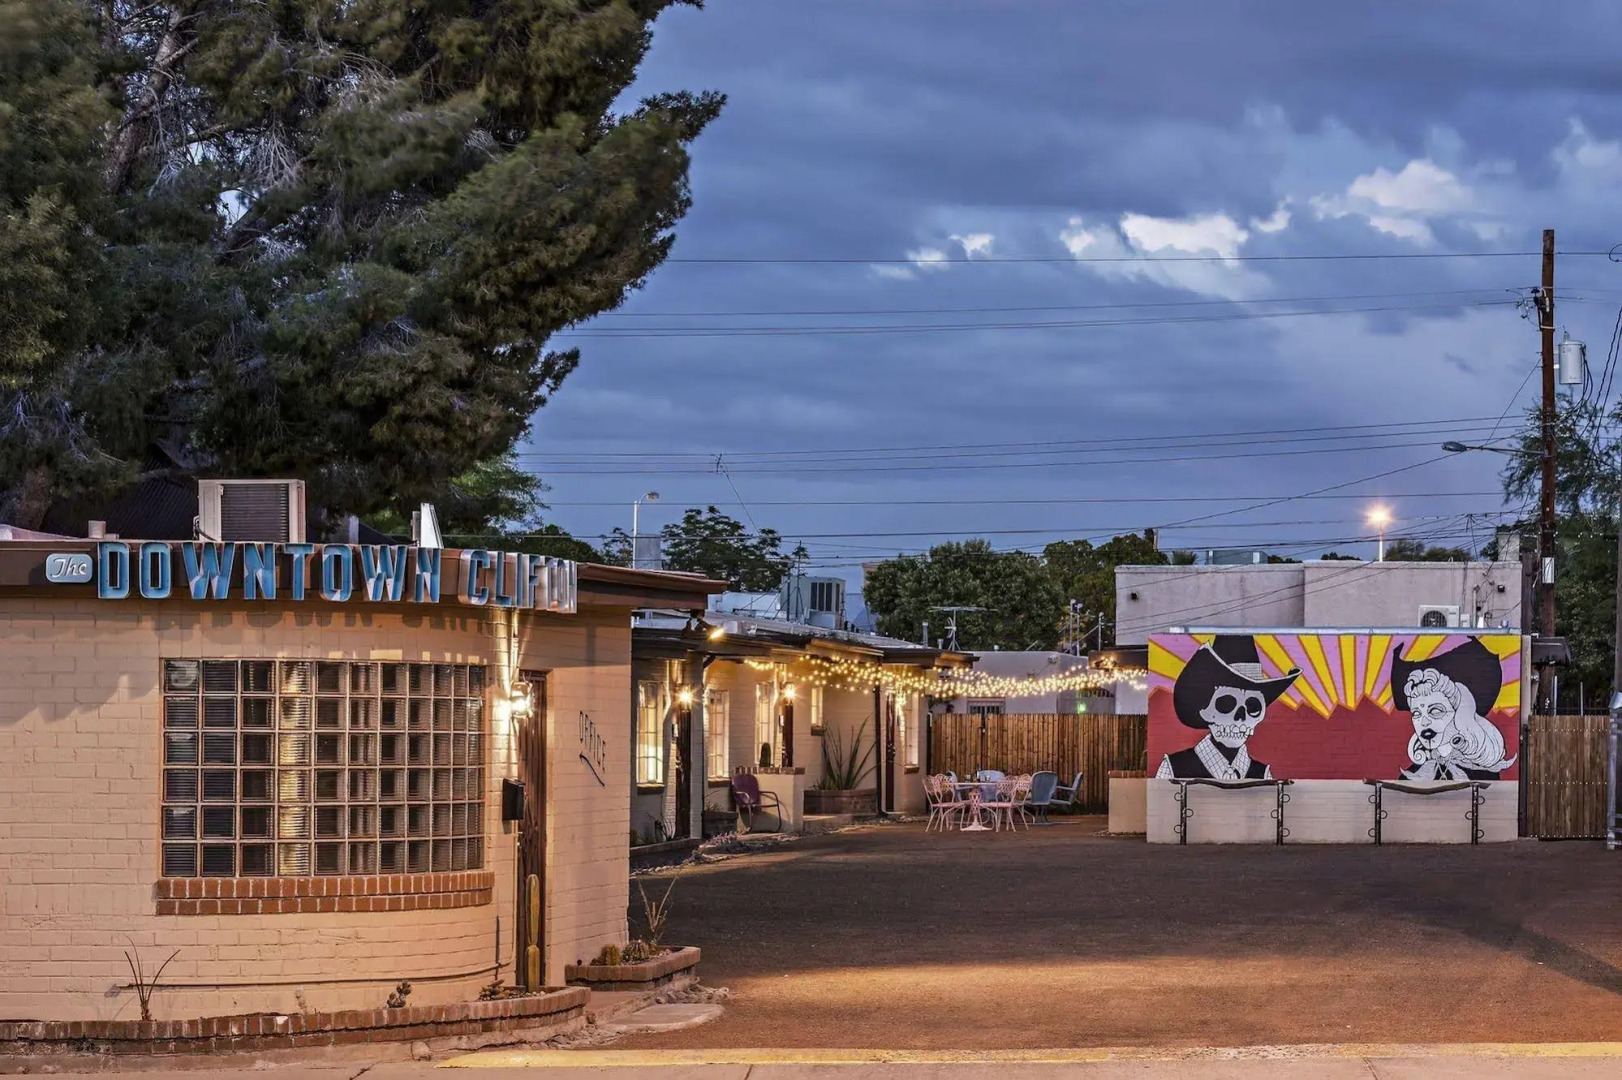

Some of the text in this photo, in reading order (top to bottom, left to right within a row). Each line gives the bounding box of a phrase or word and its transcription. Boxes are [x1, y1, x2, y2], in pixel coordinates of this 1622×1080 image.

[51, 556, 87, 578] The
[98, 541, 441, 603] DOWNTOWN
[579, 710, 606, 774] OFFICE
